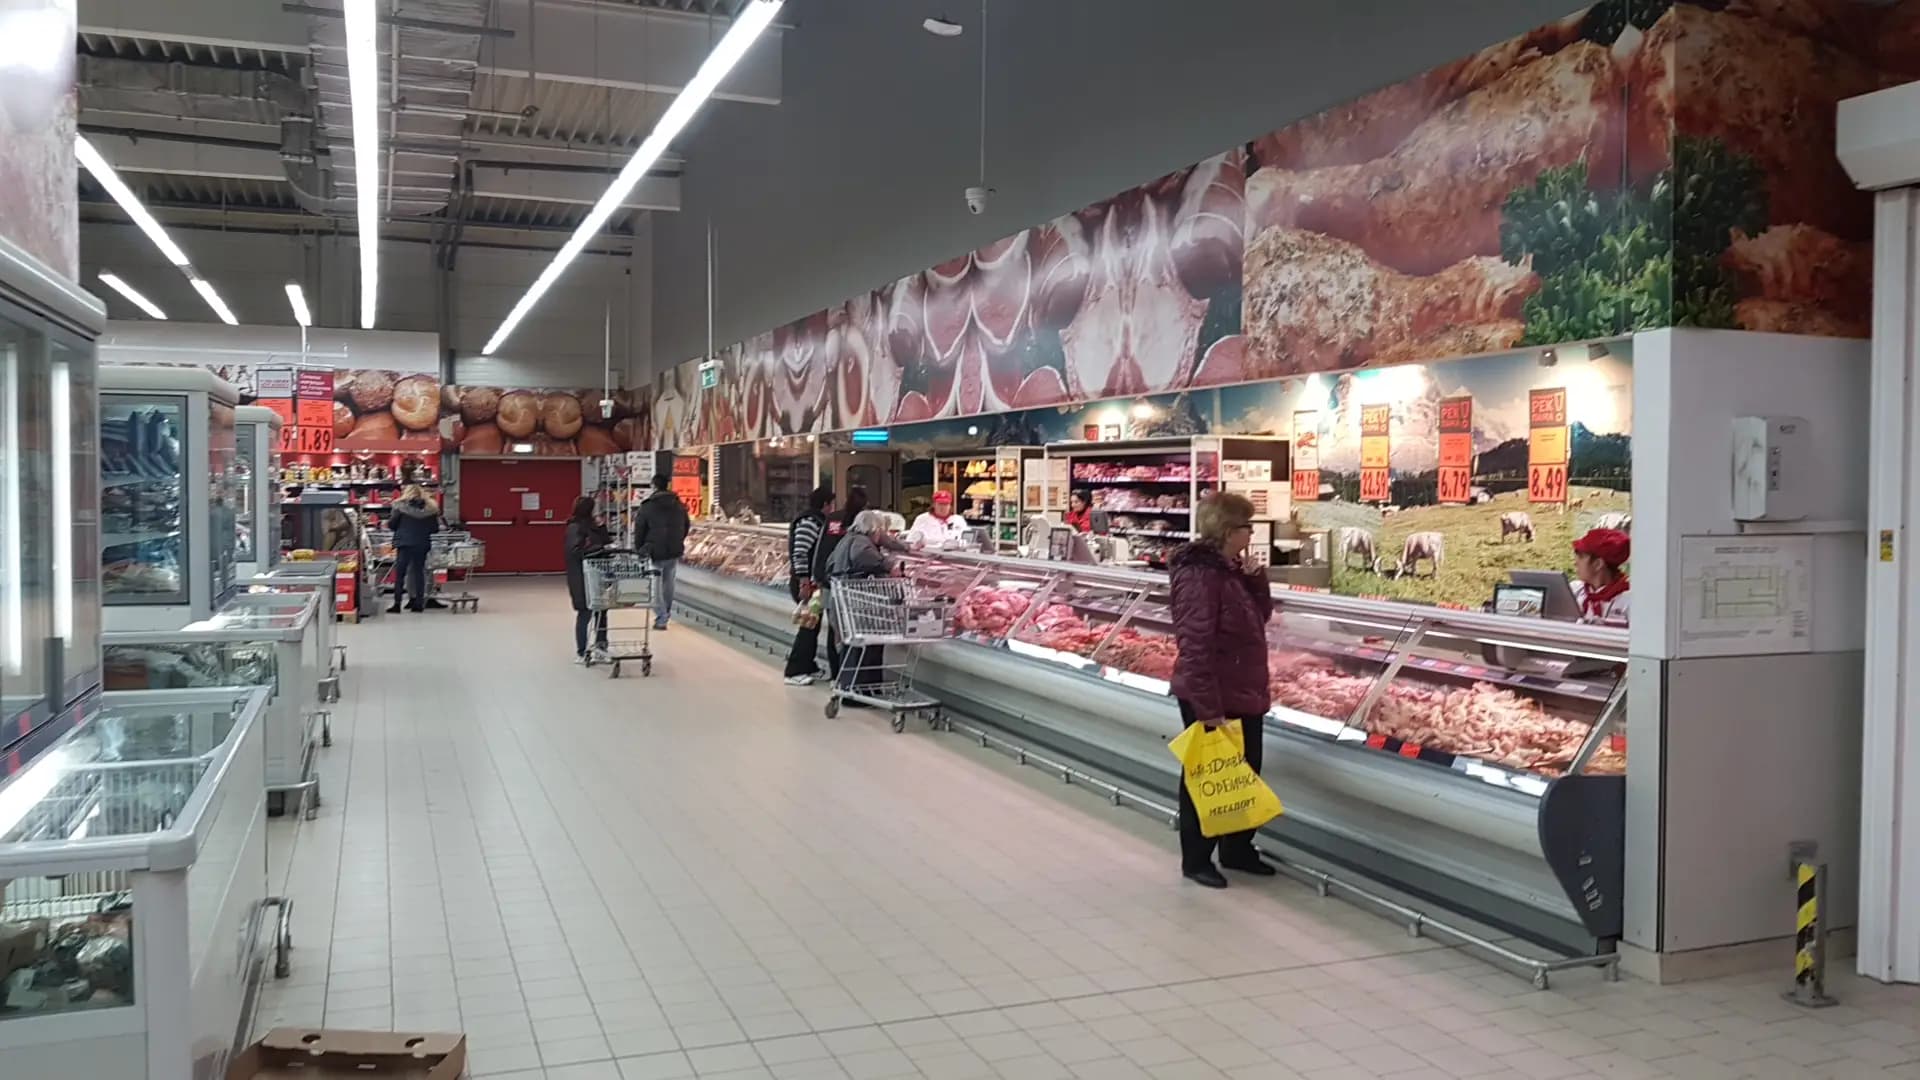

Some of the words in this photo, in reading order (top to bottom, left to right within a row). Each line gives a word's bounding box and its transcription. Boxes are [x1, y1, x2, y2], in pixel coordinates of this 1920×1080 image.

[301, 428, 331, 451] 1.89
[1440, 469, 1468, 499] 6.79
[1531, 468, 1563, 499] 8.49
